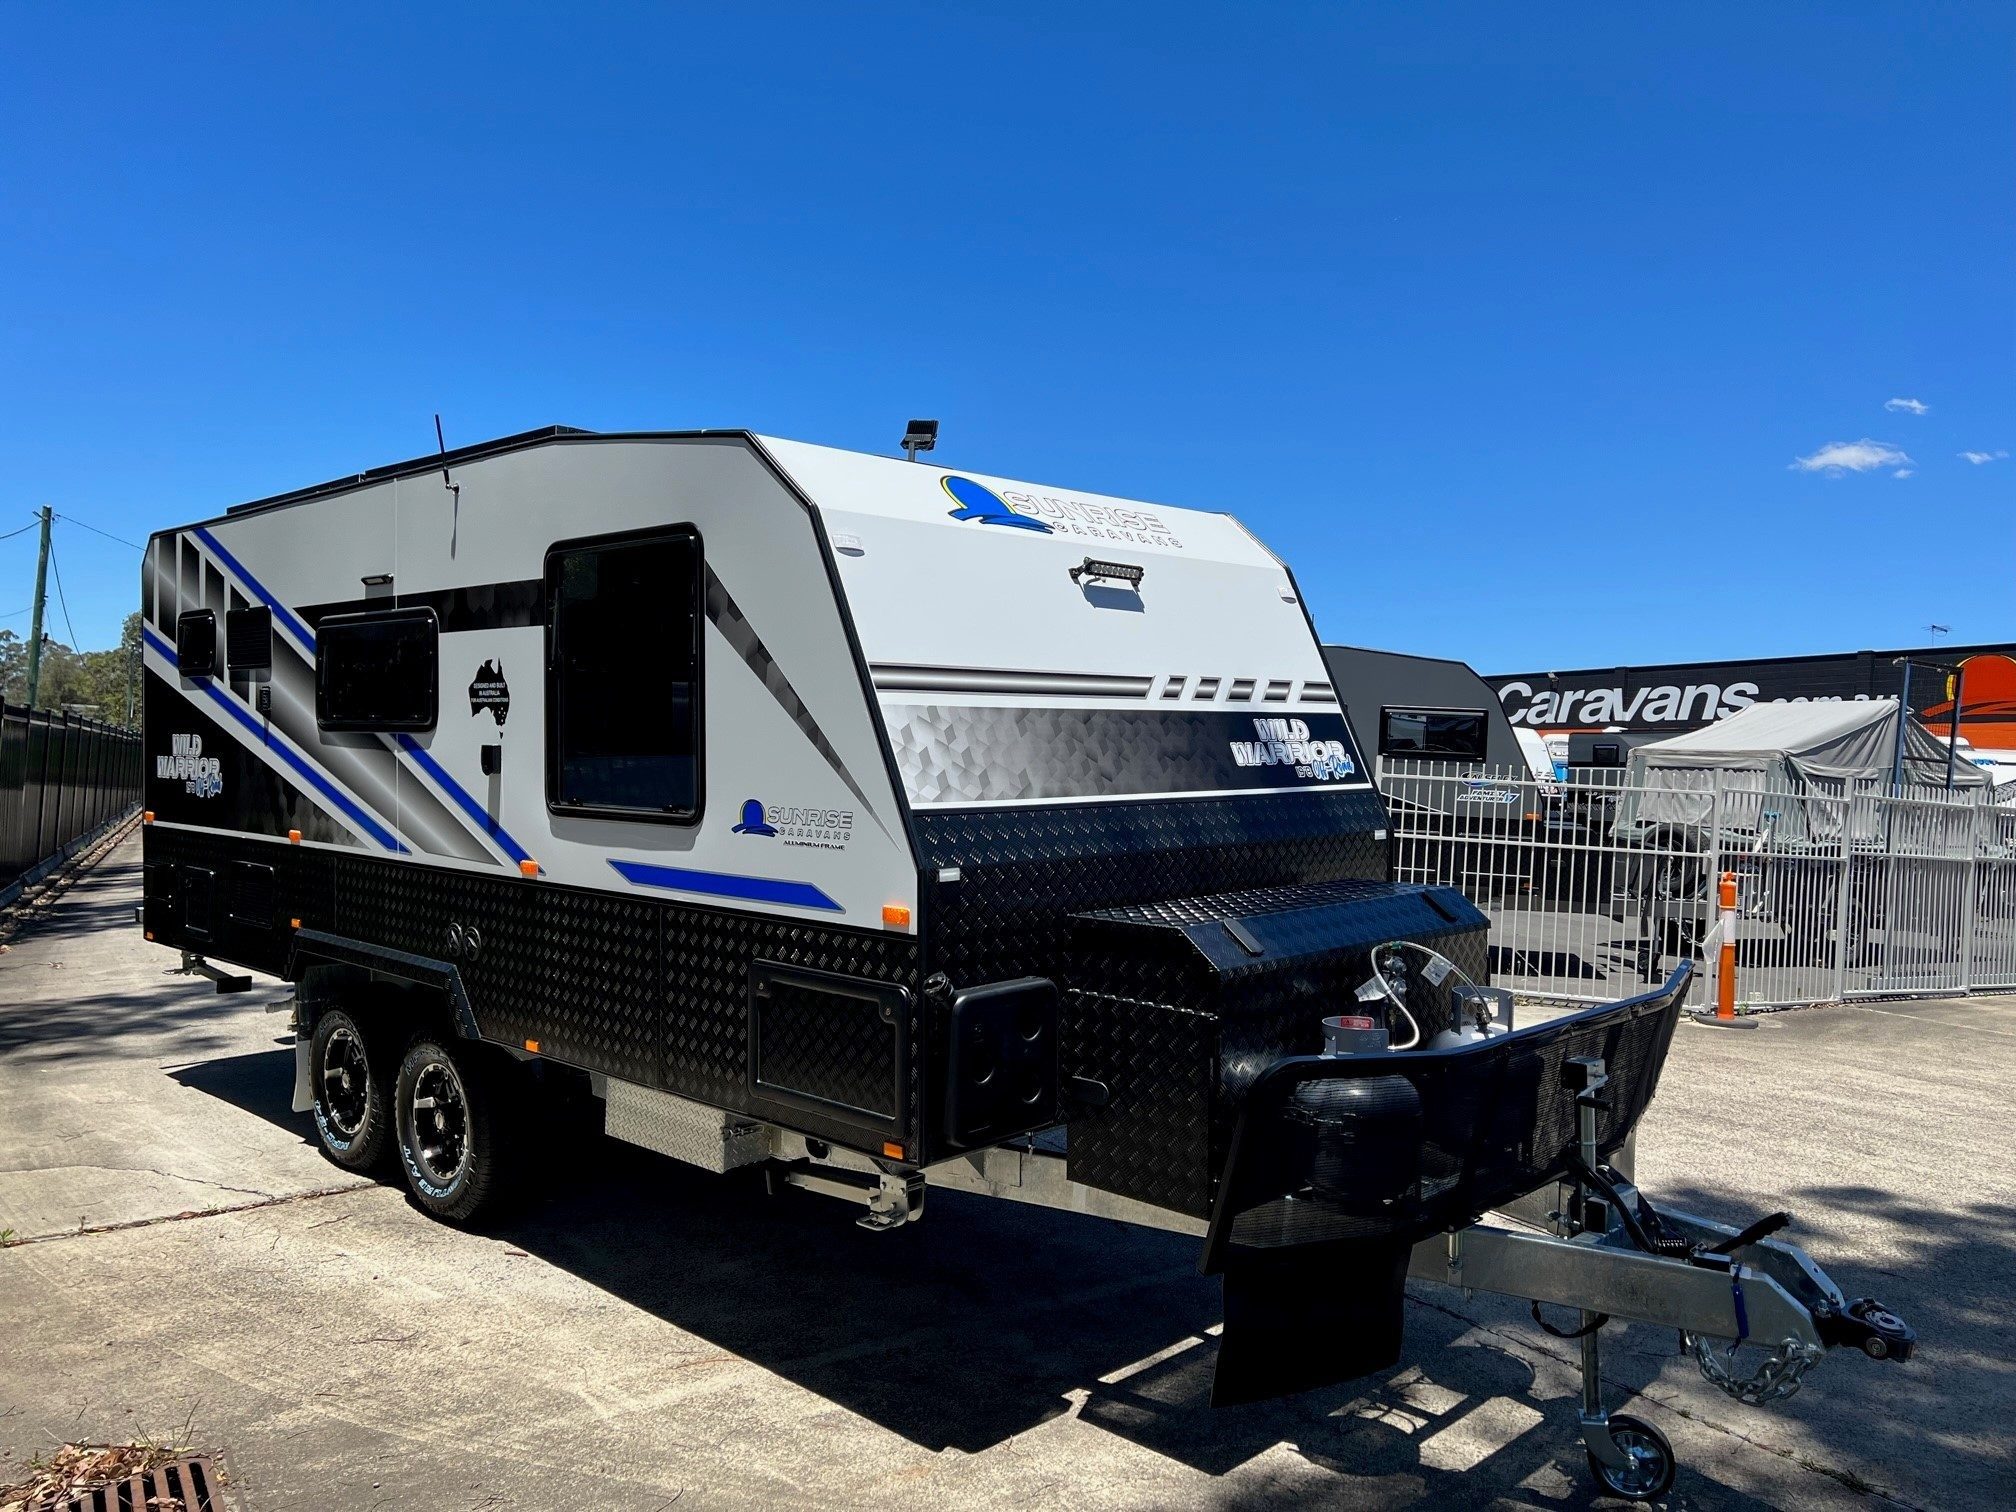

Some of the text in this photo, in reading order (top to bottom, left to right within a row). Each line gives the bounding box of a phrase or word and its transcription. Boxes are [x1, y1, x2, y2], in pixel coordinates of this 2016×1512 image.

[1003, 490, 1171, 535] SUNRISE
[1053, 521, 1183, 549] CARAVANS
[1497, 681, 1760, 725] Caravans
[1253, 718, 1310, 741] WILD
[172, 733, 202, 757] WILD
[1230, 741, 1345, 766] WARRIOR
[157, 755, 220, 780] WARRIOR
[767, 806, 853, 829] SUNRISE
[779, 827, 850, 840] CARAVANS
[783, 840, 845, 851] ALUMINIUM FRAME
